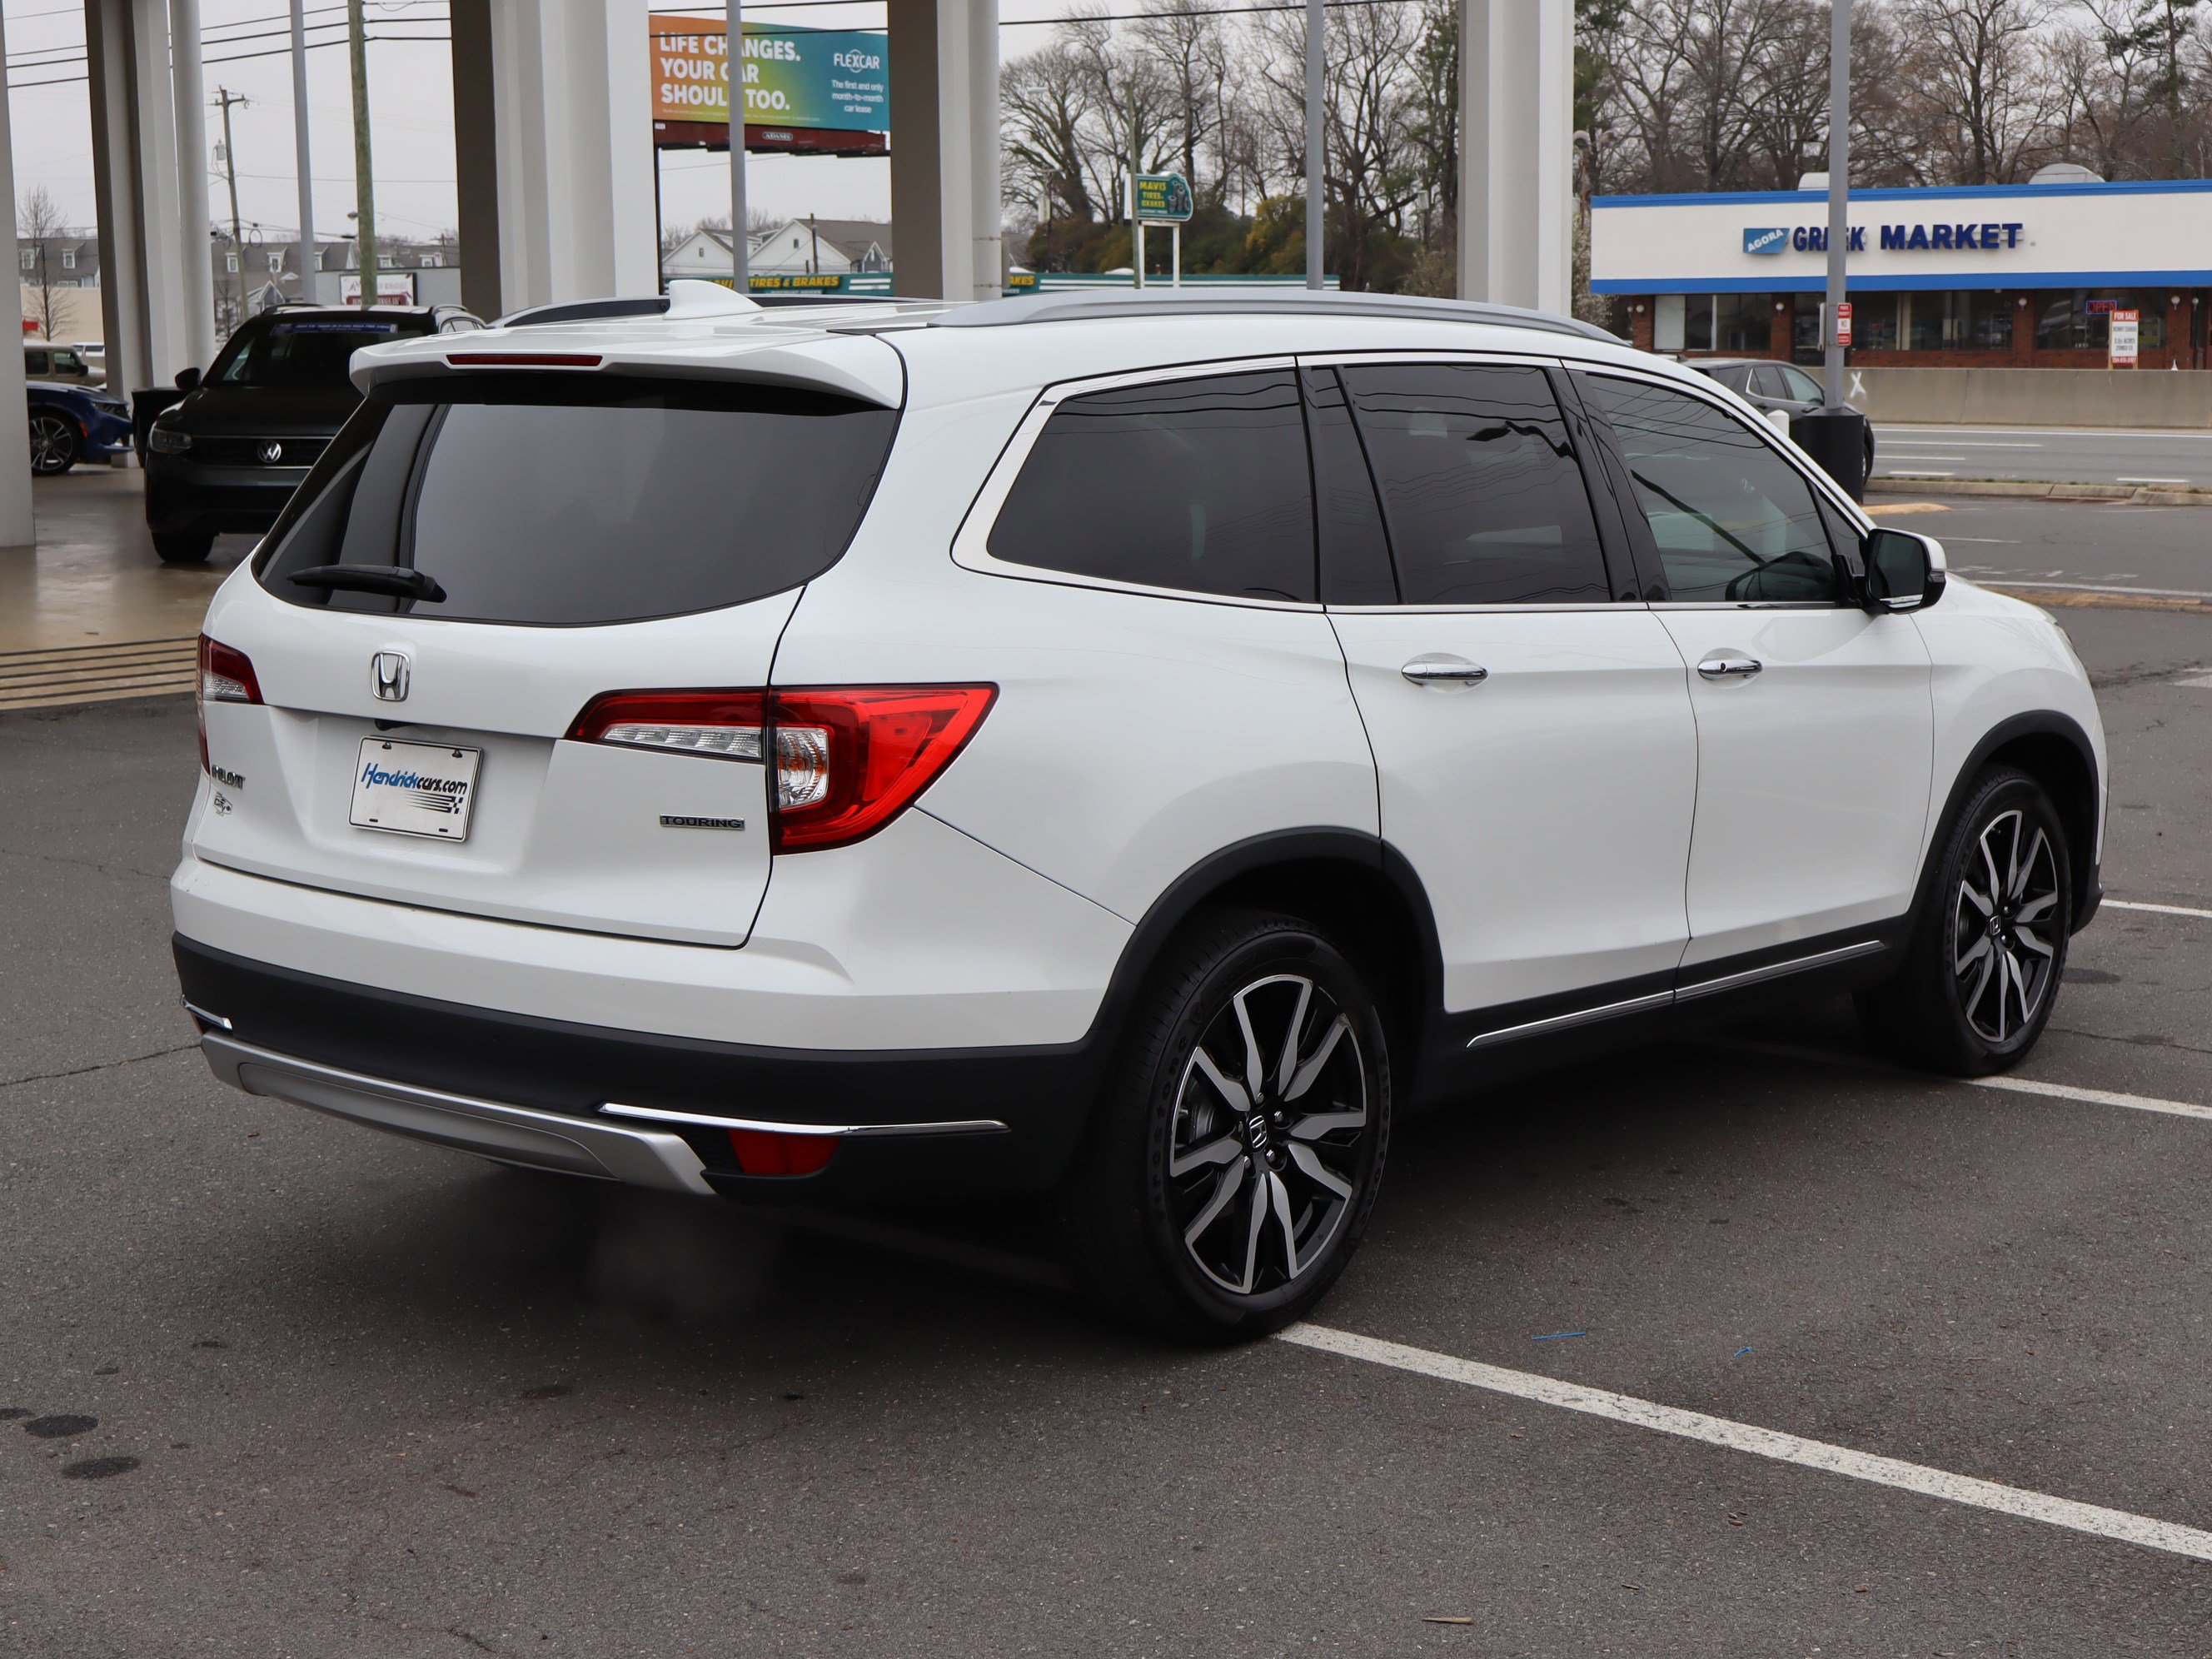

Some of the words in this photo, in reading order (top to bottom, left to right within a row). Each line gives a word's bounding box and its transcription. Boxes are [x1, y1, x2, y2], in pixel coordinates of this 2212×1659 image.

[660, 32, 700, 54] LIFE
[660, 57, 715, 81] YOUR
[834, 52, 880, 69] FLEXCAR
[832, 79, 844, 89] The
[844, 81, 858, 90] first
[858, 82, 870, 91] and
[870, 84, 884, 93] only
[660, 82, 730, 107] SHOUL
[745, 88, 791, 111] TOO.
[832, 92, 884, 102] month-to-month
[844, 105, 854, 113] car
[854, 105, 873, 114] lease
[1139, 182, 1166, 191] MAVIS
[1747, 228, 1785, 253] AGORA
[1792, 227, 1866, 252] GRK
[1881, 223, 2023, 250] MARKET
[750, 276, 781, 288] TIRES
[792, 276, 839, 286] BRAKES
[2089, 301, 2115, 312] OPEN
[212, 764, 246, 790] PILOT
[361, 762, 468, 795] Hendrickcars.com
[661, 815, 741, 829] TOURING
